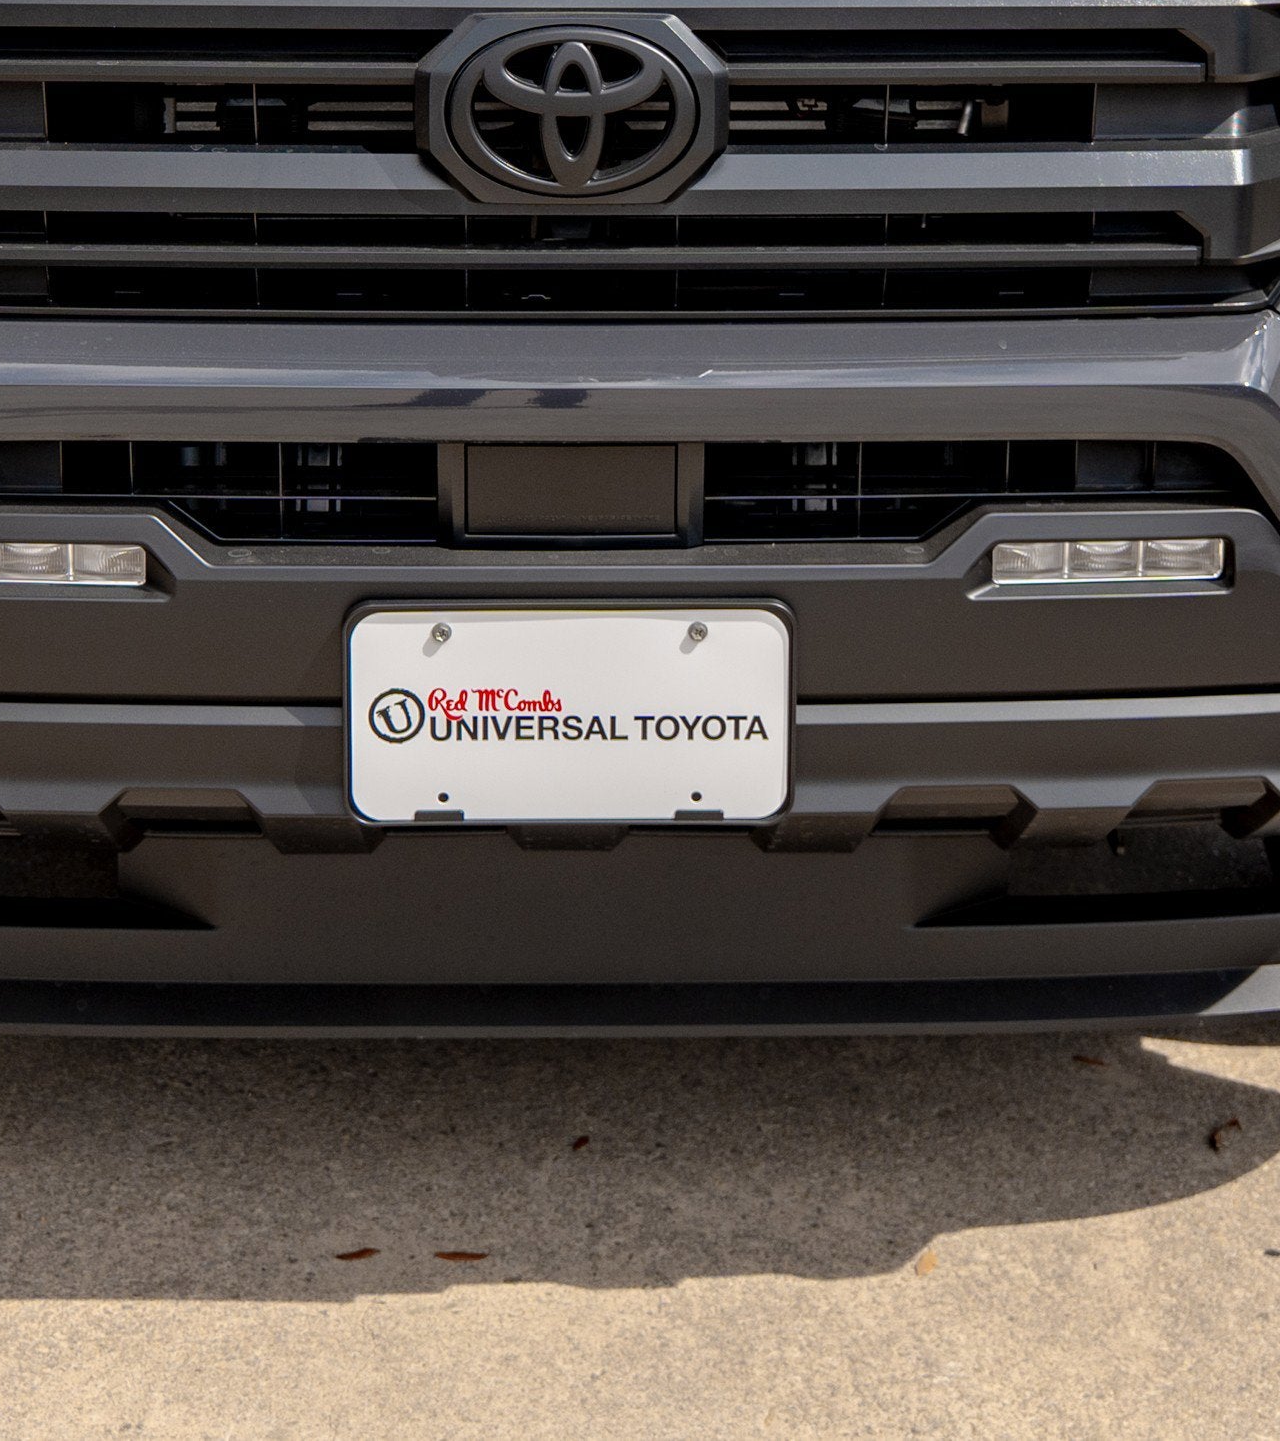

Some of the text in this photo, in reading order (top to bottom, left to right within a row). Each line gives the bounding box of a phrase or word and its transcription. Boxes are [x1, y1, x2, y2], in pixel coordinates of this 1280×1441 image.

[427, 688, 563, 721] Red McCombs
[430, 714, 769, 742] UNIVERSAL TOYOTA
